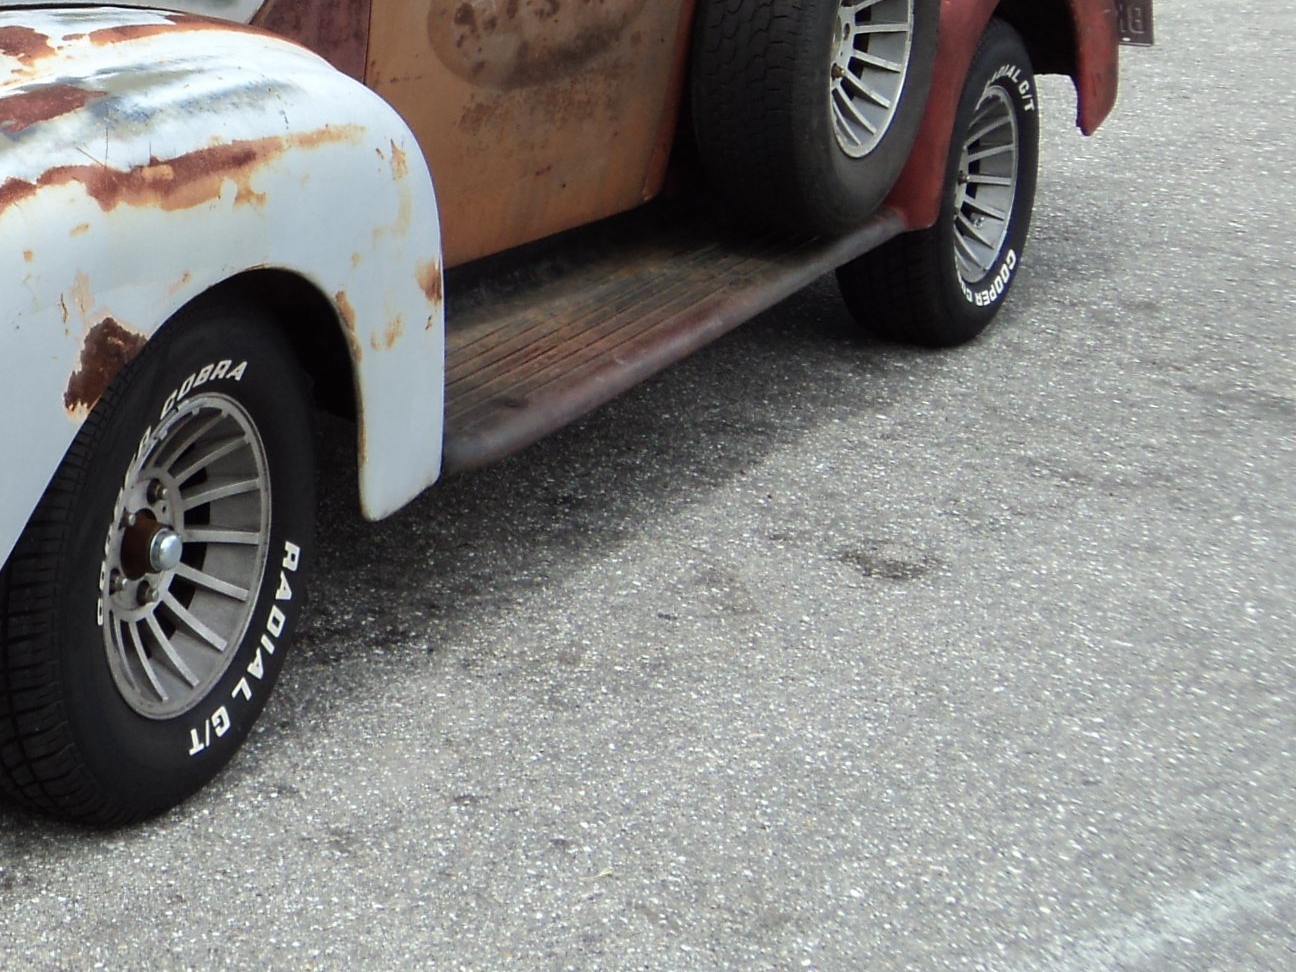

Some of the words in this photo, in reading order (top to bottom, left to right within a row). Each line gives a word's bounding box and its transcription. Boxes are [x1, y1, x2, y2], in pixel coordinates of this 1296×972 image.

[1018, 79, 1035, 112] G/T
[974, 248, 1017, 307] COOPER
[160, 359, 248, 421] COBRA
[230, 540, 301, 701] RADIAL
[188, 705, 231, 756] G/T
